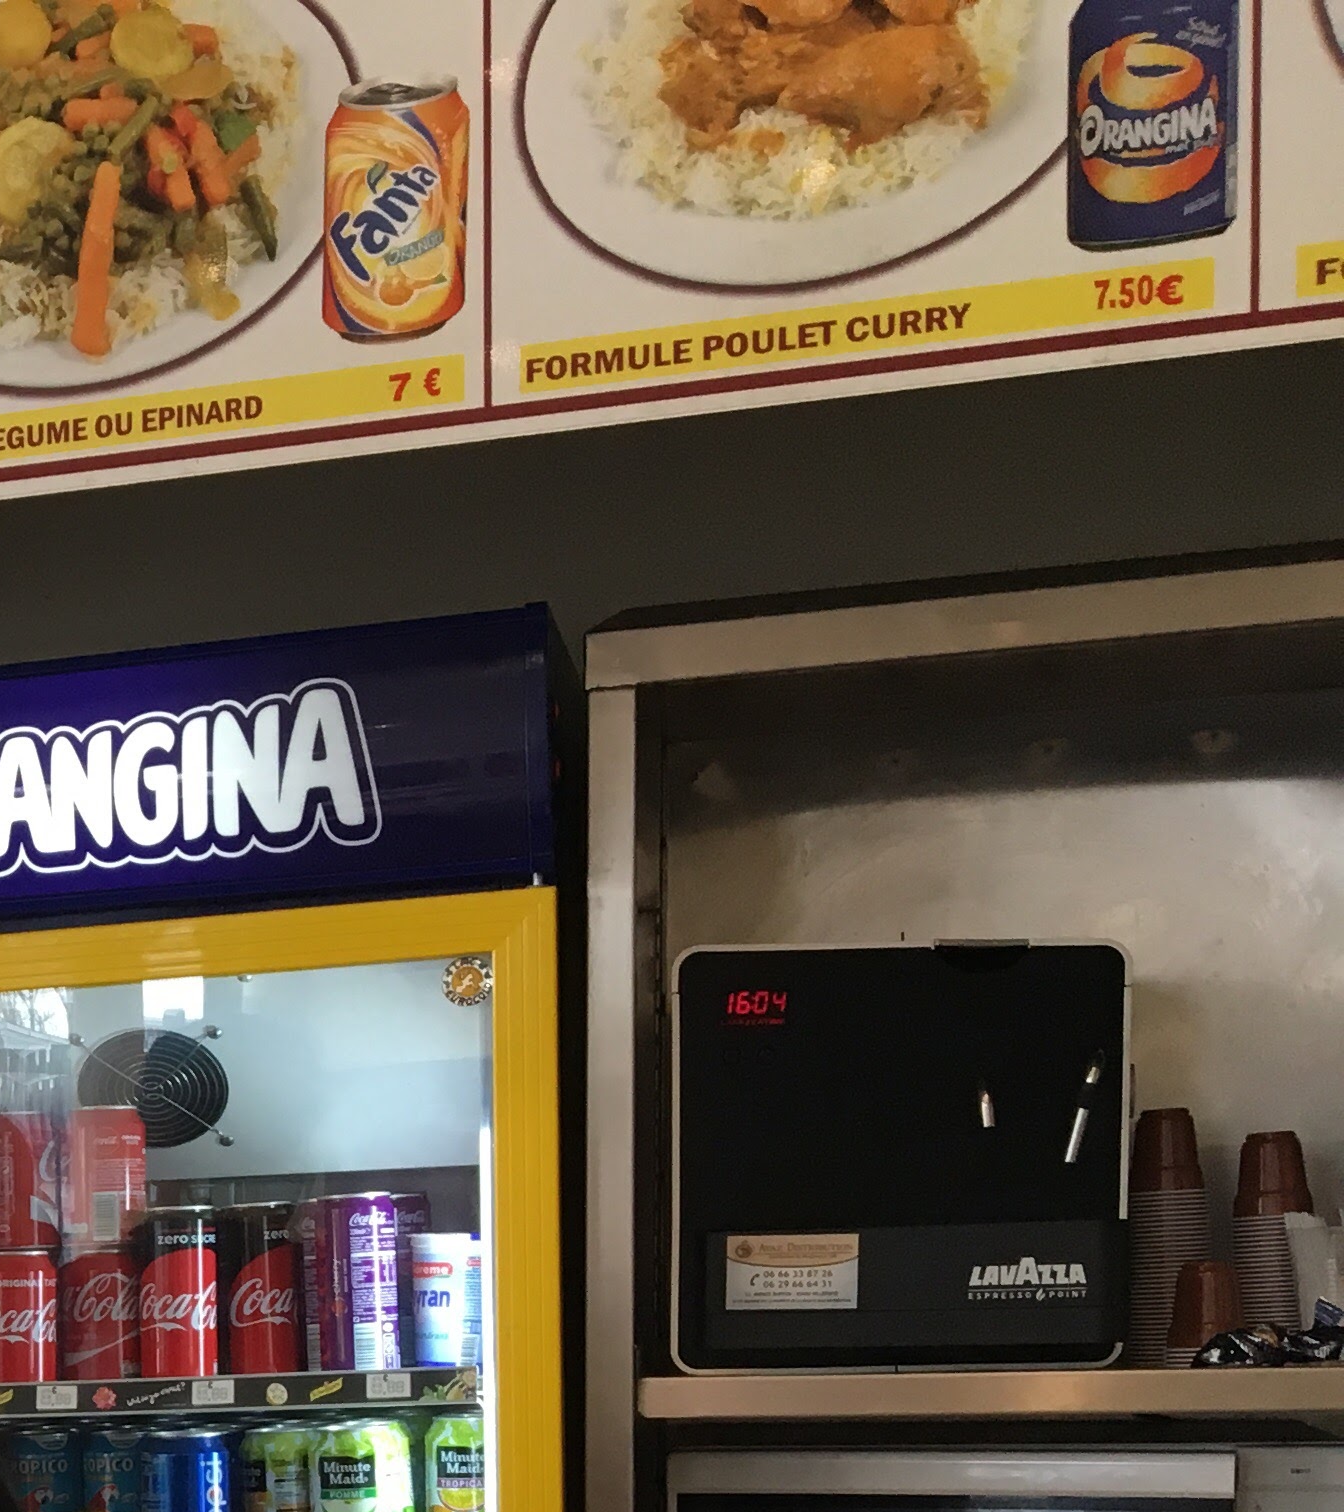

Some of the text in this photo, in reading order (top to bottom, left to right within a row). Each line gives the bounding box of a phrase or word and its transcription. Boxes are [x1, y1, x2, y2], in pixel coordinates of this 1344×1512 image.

[1078, 96, 1218, 157] ORANGINA
[328, 164, 440, 284] Fanta
[525, 302, 973, 384] FORMULE POULET CURRY
[388, 367, 443, 403] 7 €
[94, 411, 133, 440] OU
[140, 395, 265, 435] EPINARD
[157, 1234, 189, 1246] zero
[263, 1230, 290, 1241] zero
[968, 1256, 1088, 1287] LAVAZZA
[967, 1290, 1088, 1300] ESPRESSO POINT
[323, 1461, 371, 1472] Minute
[328, 1473, 368, 1485] Maid
[440, 1479, 484, 1488] TROPICA
